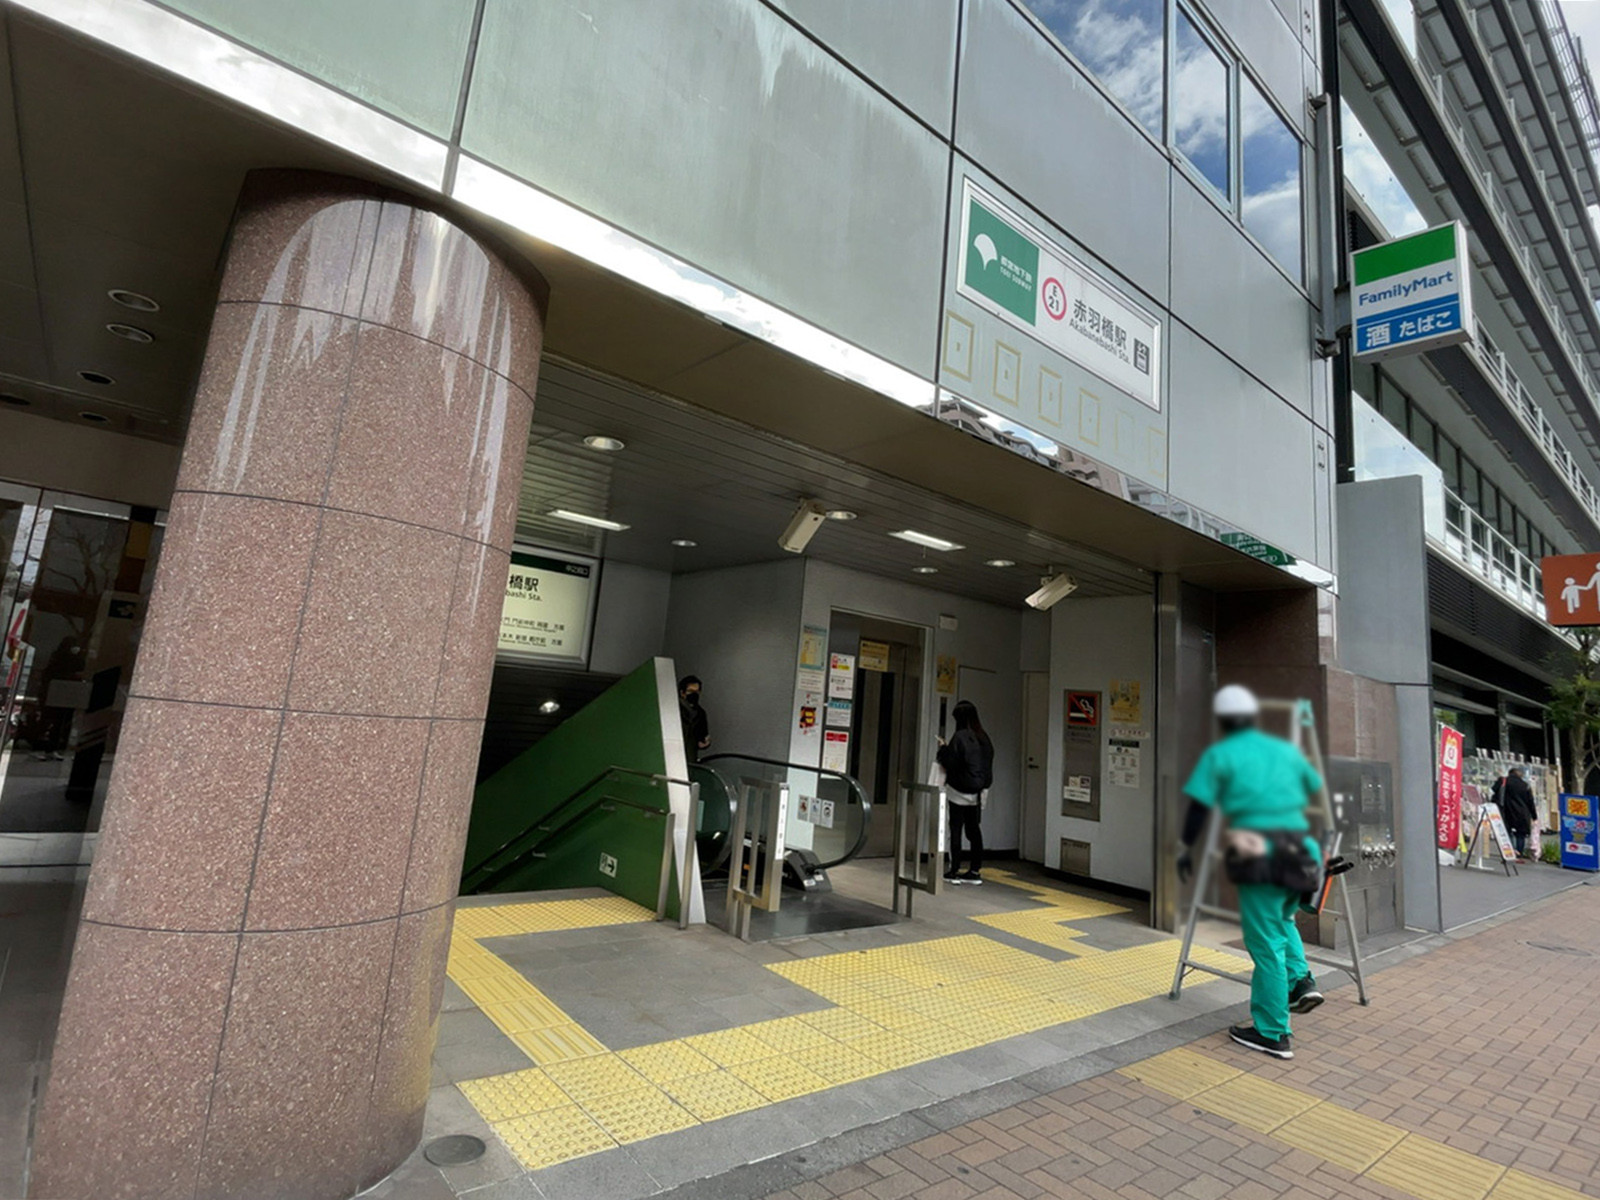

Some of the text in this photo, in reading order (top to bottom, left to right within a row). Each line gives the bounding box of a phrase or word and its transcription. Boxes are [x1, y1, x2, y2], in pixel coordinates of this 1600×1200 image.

[1048, 296, 1060, 312] 21
[1052, 285, 1058, 297] E
[1359, 271, 1454, 306] FamilyMart
[1069, 318, 1117, 357] Akabanebashi
[1073, 299, 1127, 350] 赤羽橋駅
[1366, 310, 1453, 347] 酒 たばこ
[509, 573, 539, 592] 橋駅
